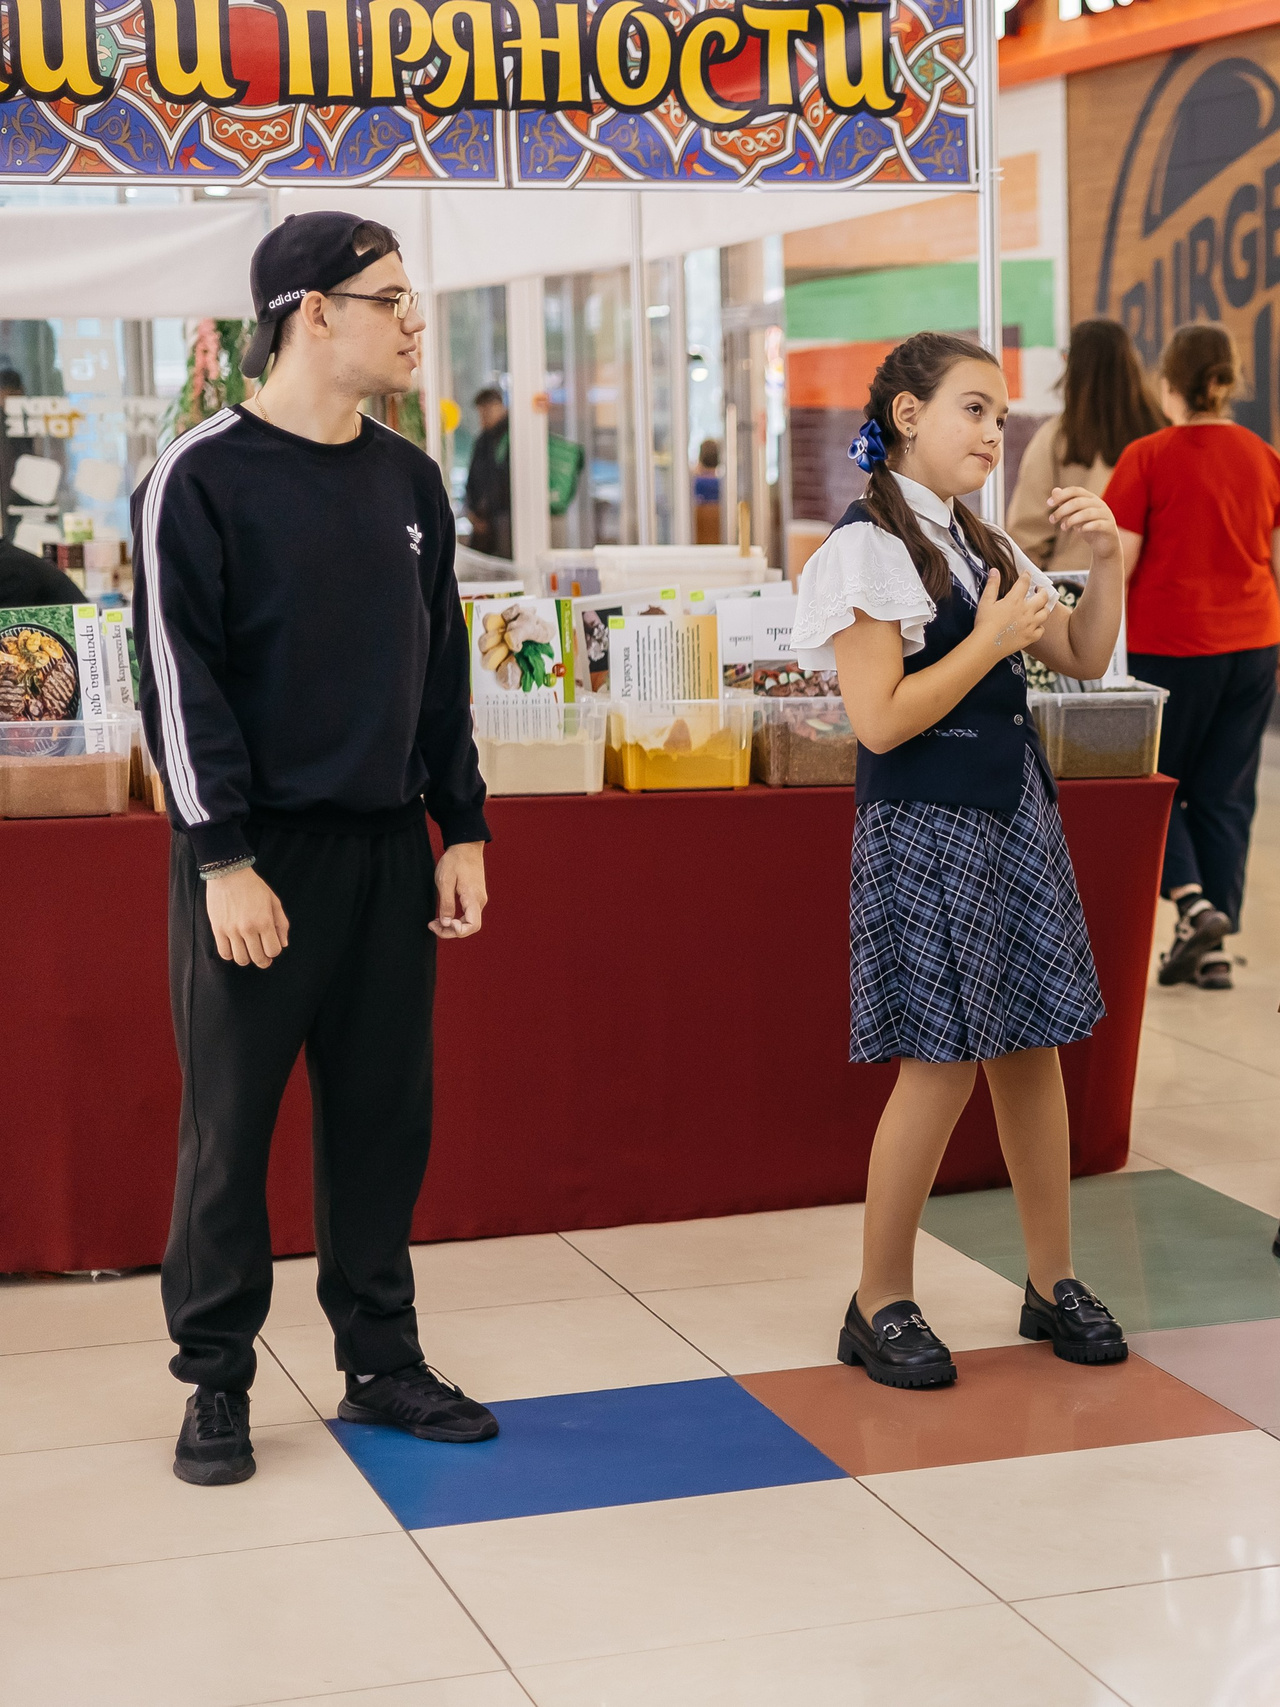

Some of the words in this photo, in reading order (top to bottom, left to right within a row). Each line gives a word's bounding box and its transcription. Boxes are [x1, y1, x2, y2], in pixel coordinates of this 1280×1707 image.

[268, 289, 307, 309] adidas
[79, 624, 100, 689] приправа
[621, 647, 633, 698] Куркума
[85, 687, 103, 716] для
